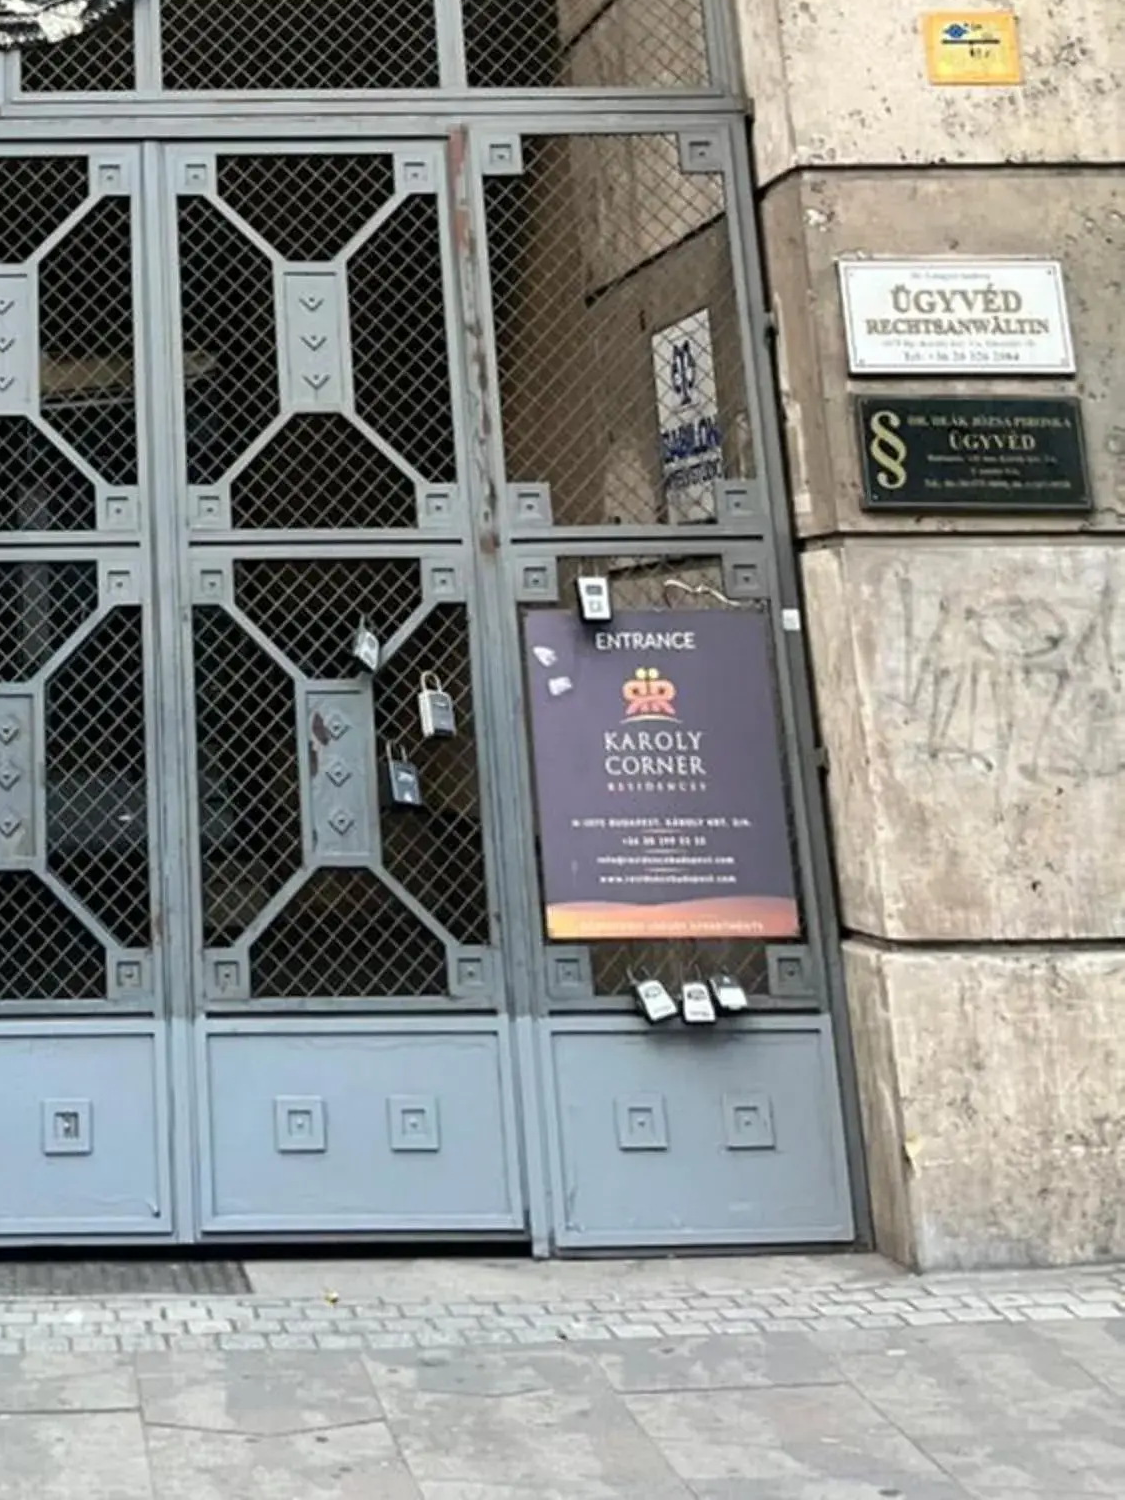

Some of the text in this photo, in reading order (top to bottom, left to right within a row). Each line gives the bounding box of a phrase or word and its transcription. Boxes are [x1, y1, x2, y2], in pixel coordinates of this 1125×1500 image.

[891, 282, 1023, 313] ÜGYVÉD
[865, 316, 1050, 336] RECHTSANWÄLTIN
[948, 430, 1037, 451] ÜGYVÉD
[595, 631, 696, 650] ENTRANCE
[603, 731, 703, 751] KAROLY
[604, 755, 707, 776] CORNER
